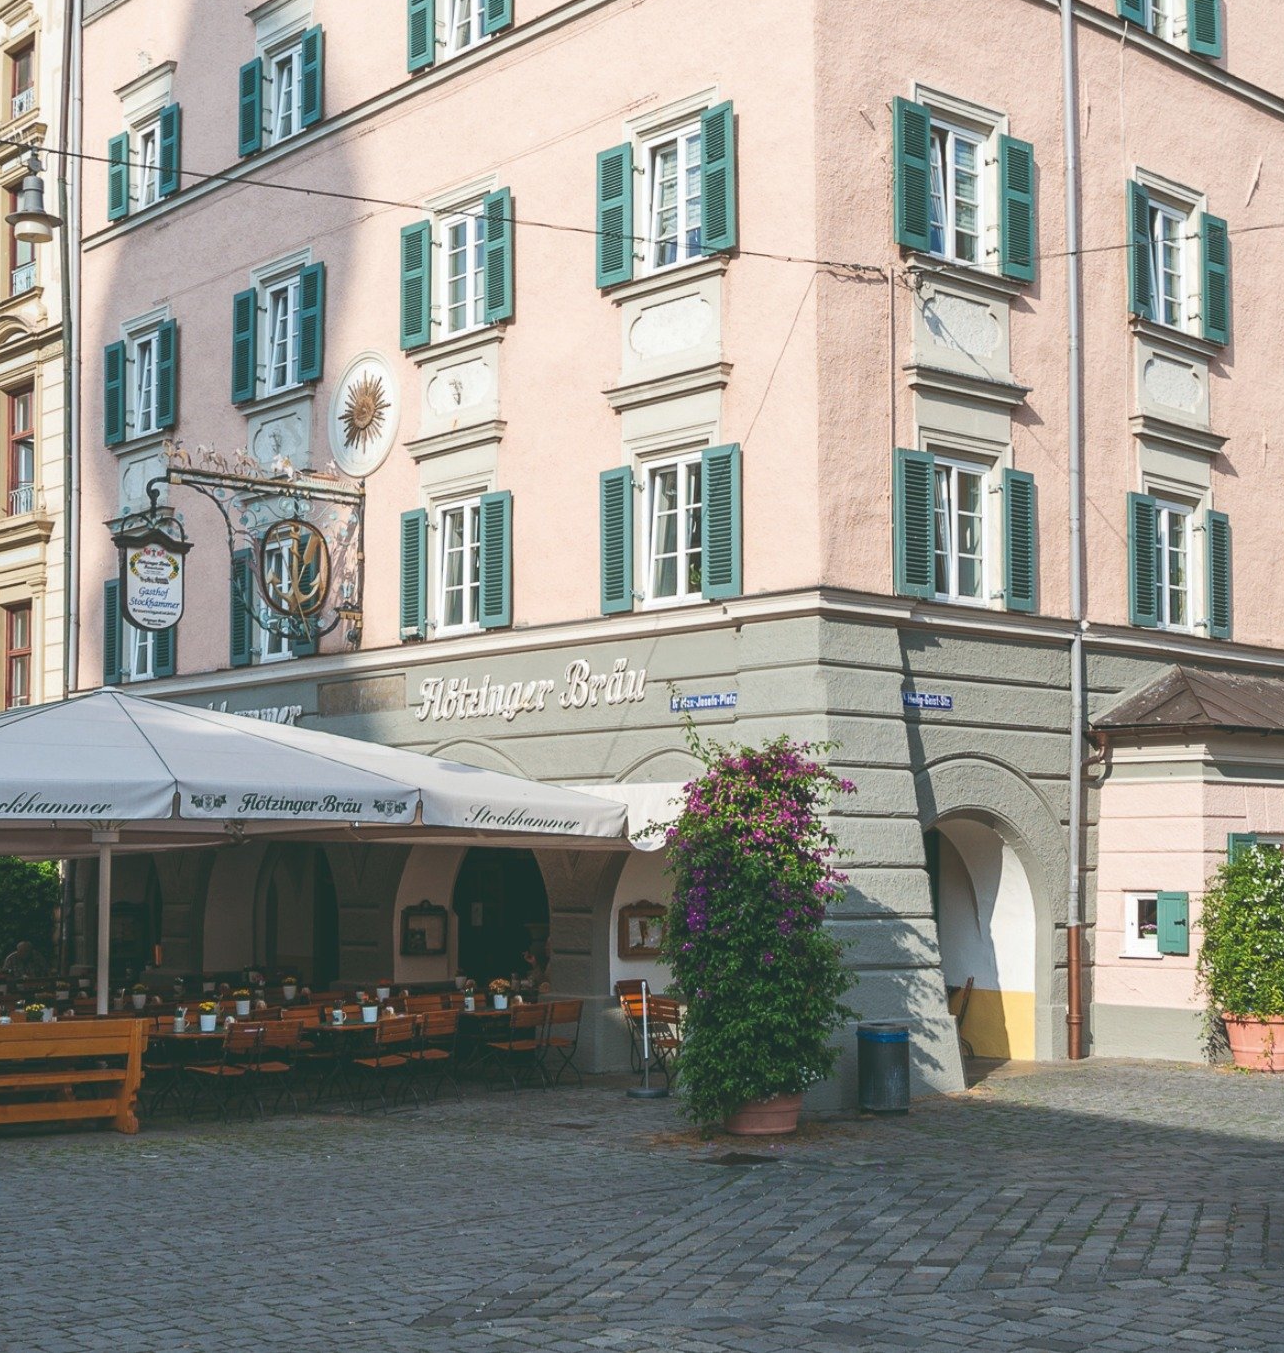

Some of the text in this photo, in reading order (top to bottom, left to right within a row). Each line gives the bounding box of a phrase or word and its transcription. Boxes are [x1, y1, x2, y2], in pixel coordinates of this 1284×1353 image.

[129, 597, 180, 609] Stockhammer
[139, 587, 170, 599] Gasthof
[415, 657, 647, 721] Flötzinger Bräu
[237, 793, 363, 815] Flötzinger Bräu
[465, 804, 581, 830] Stockhammer
